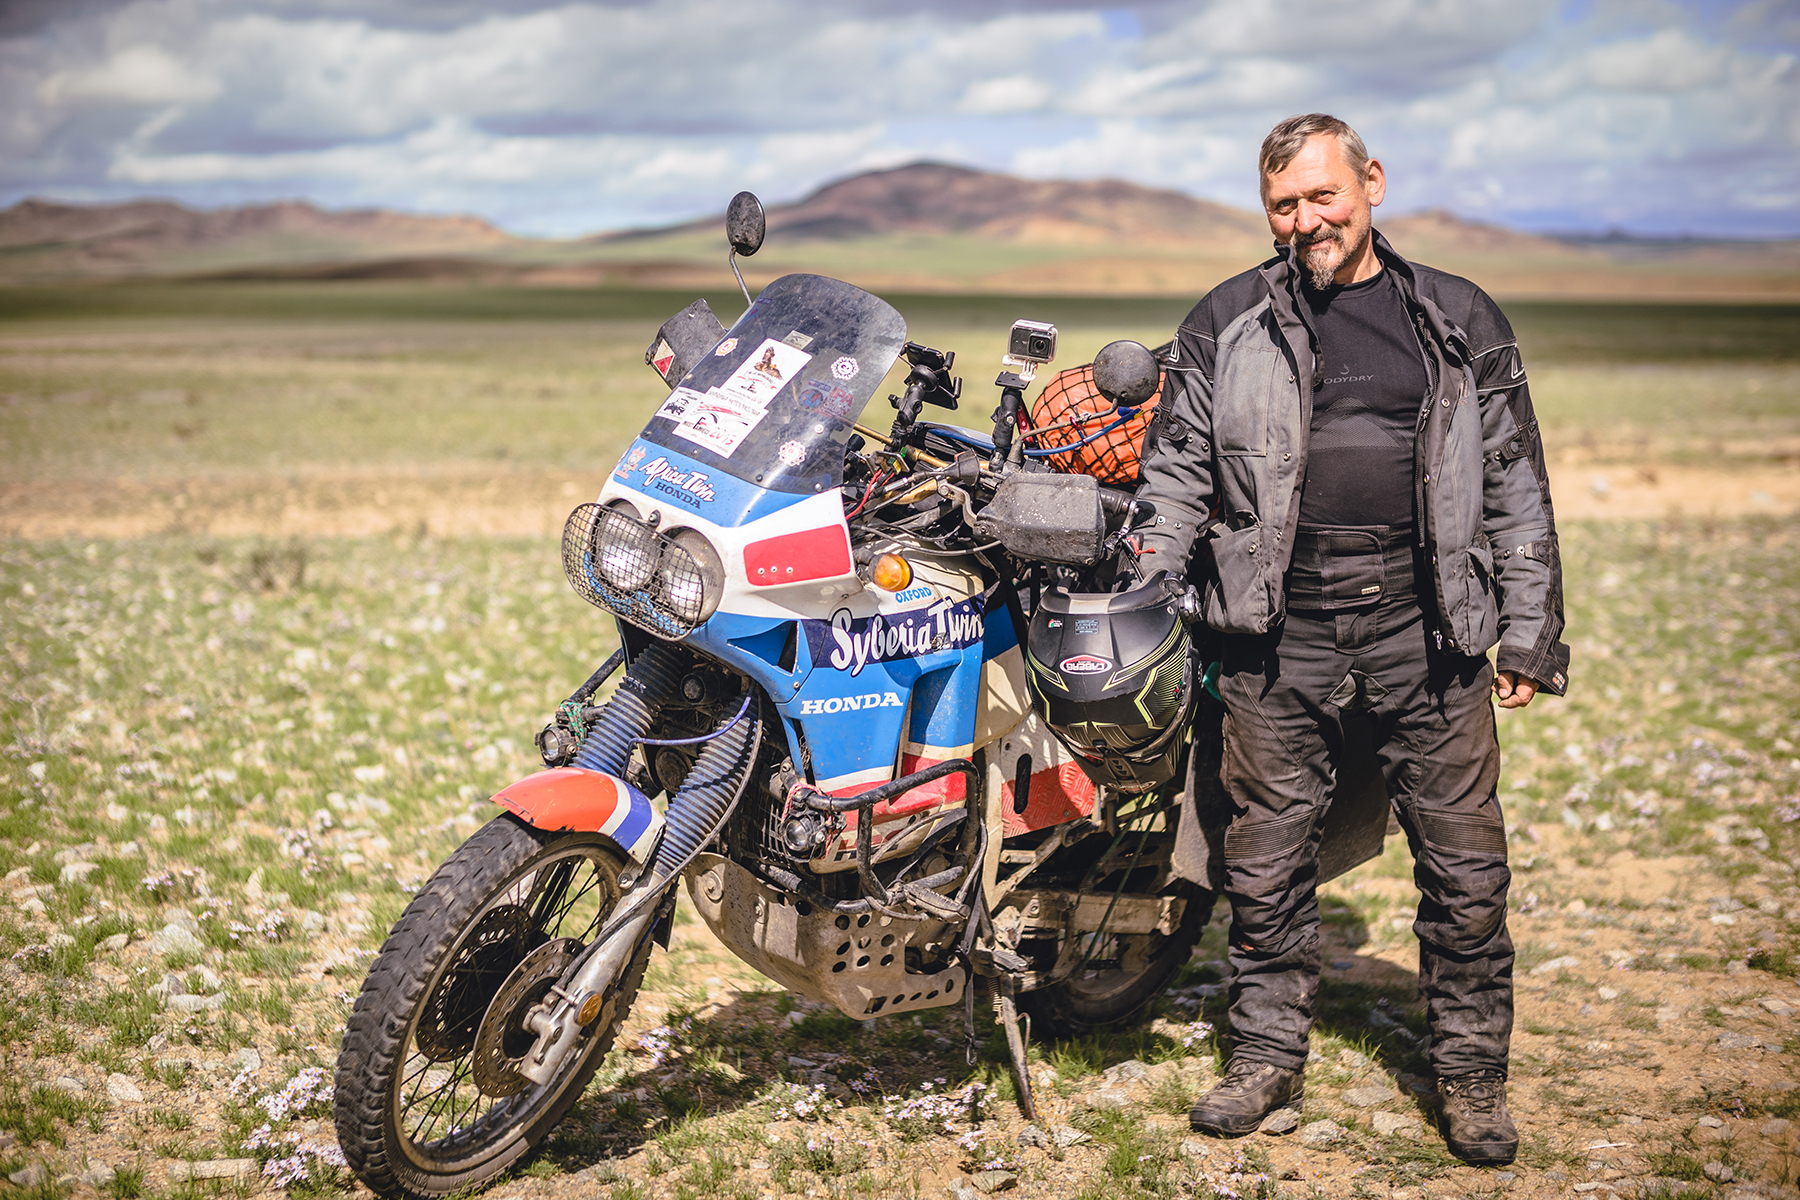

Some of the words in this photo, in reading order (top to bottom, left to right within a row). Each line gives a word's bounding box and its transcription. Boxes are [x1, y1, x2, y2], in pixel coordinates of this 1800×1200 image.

[1323, 374, 1375, 385] ODYDRY
[638, 456, 689, 487] Africa
[681, 471, 717, 502] Twin
[655, 482, 701, 509] HONDA
[895, 586, 932, 604] OXFORD
[830, 607, 933, 677] Syberia
[927, 598, 985, 644] Twin
[800, 692, 904, 715] HONDA
